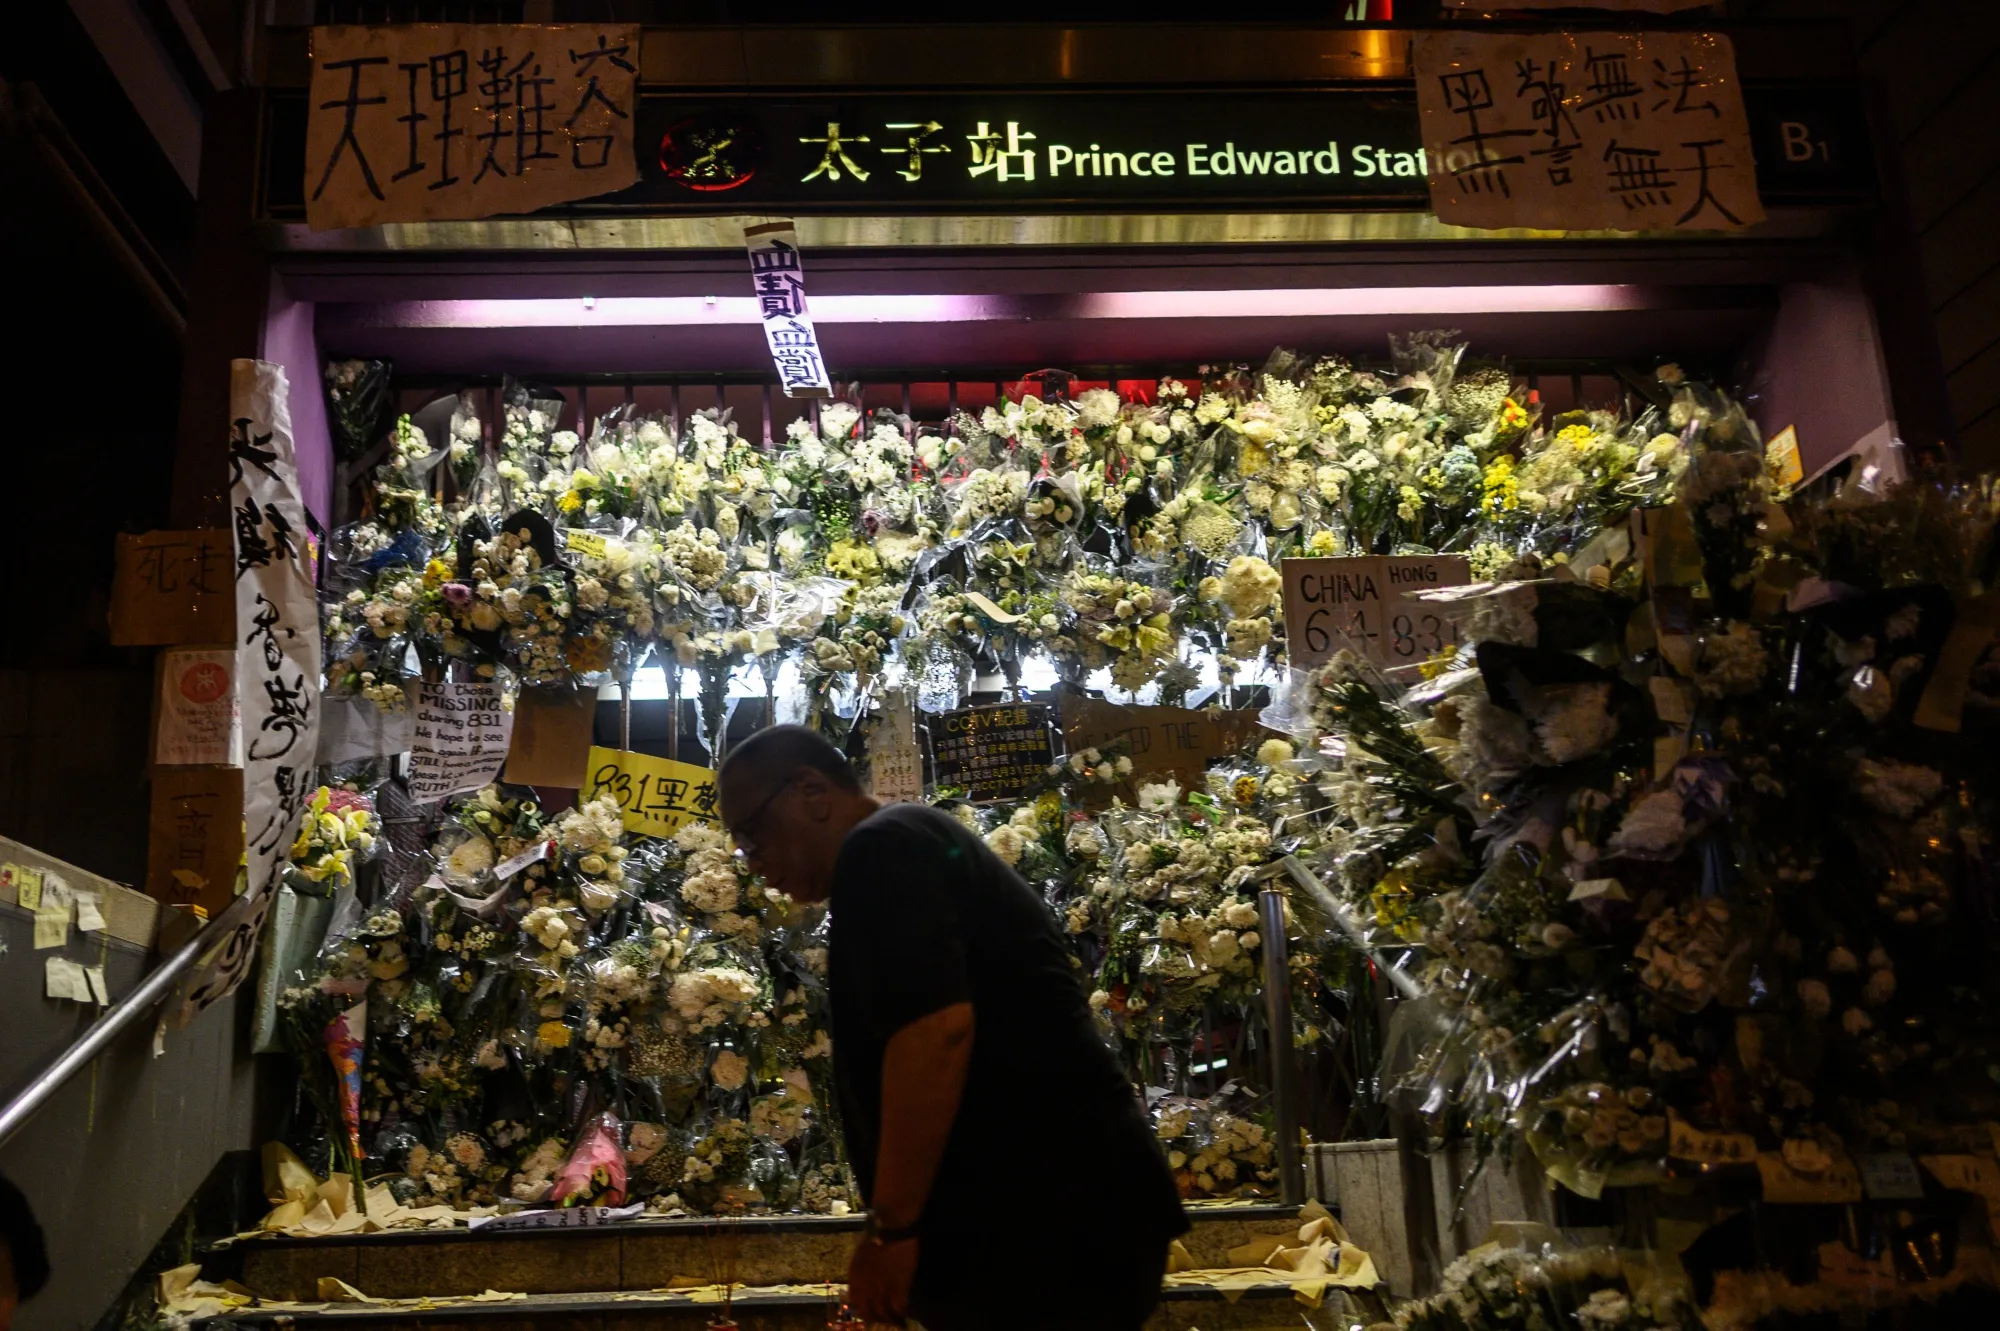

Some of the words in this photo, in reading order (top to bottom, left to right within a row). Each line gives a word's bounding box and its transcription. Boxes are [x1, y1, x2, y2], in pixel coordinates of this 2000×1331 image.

[311, 35, 637, 202] 天理難容
[798, 119, 1037, 183] 太子站
[1780, 122, 1831, 163] B1
[1048, 142, 1175, 178] Prince
[1186, 140, 1341, 178] Edward
[1389, 565, 1438, 584] HONG
[419, 693, 502, 712] MISSING
[454, 684, 494, 696] those
[418, 709, 464, 729] during
[467, 713, 502, 727] 831
[436, 729, 464, 743] hope
[468, 732, 480, 742] to
[484, 733, 504, 742] see
[1159, 721, 1201, 755] THE
